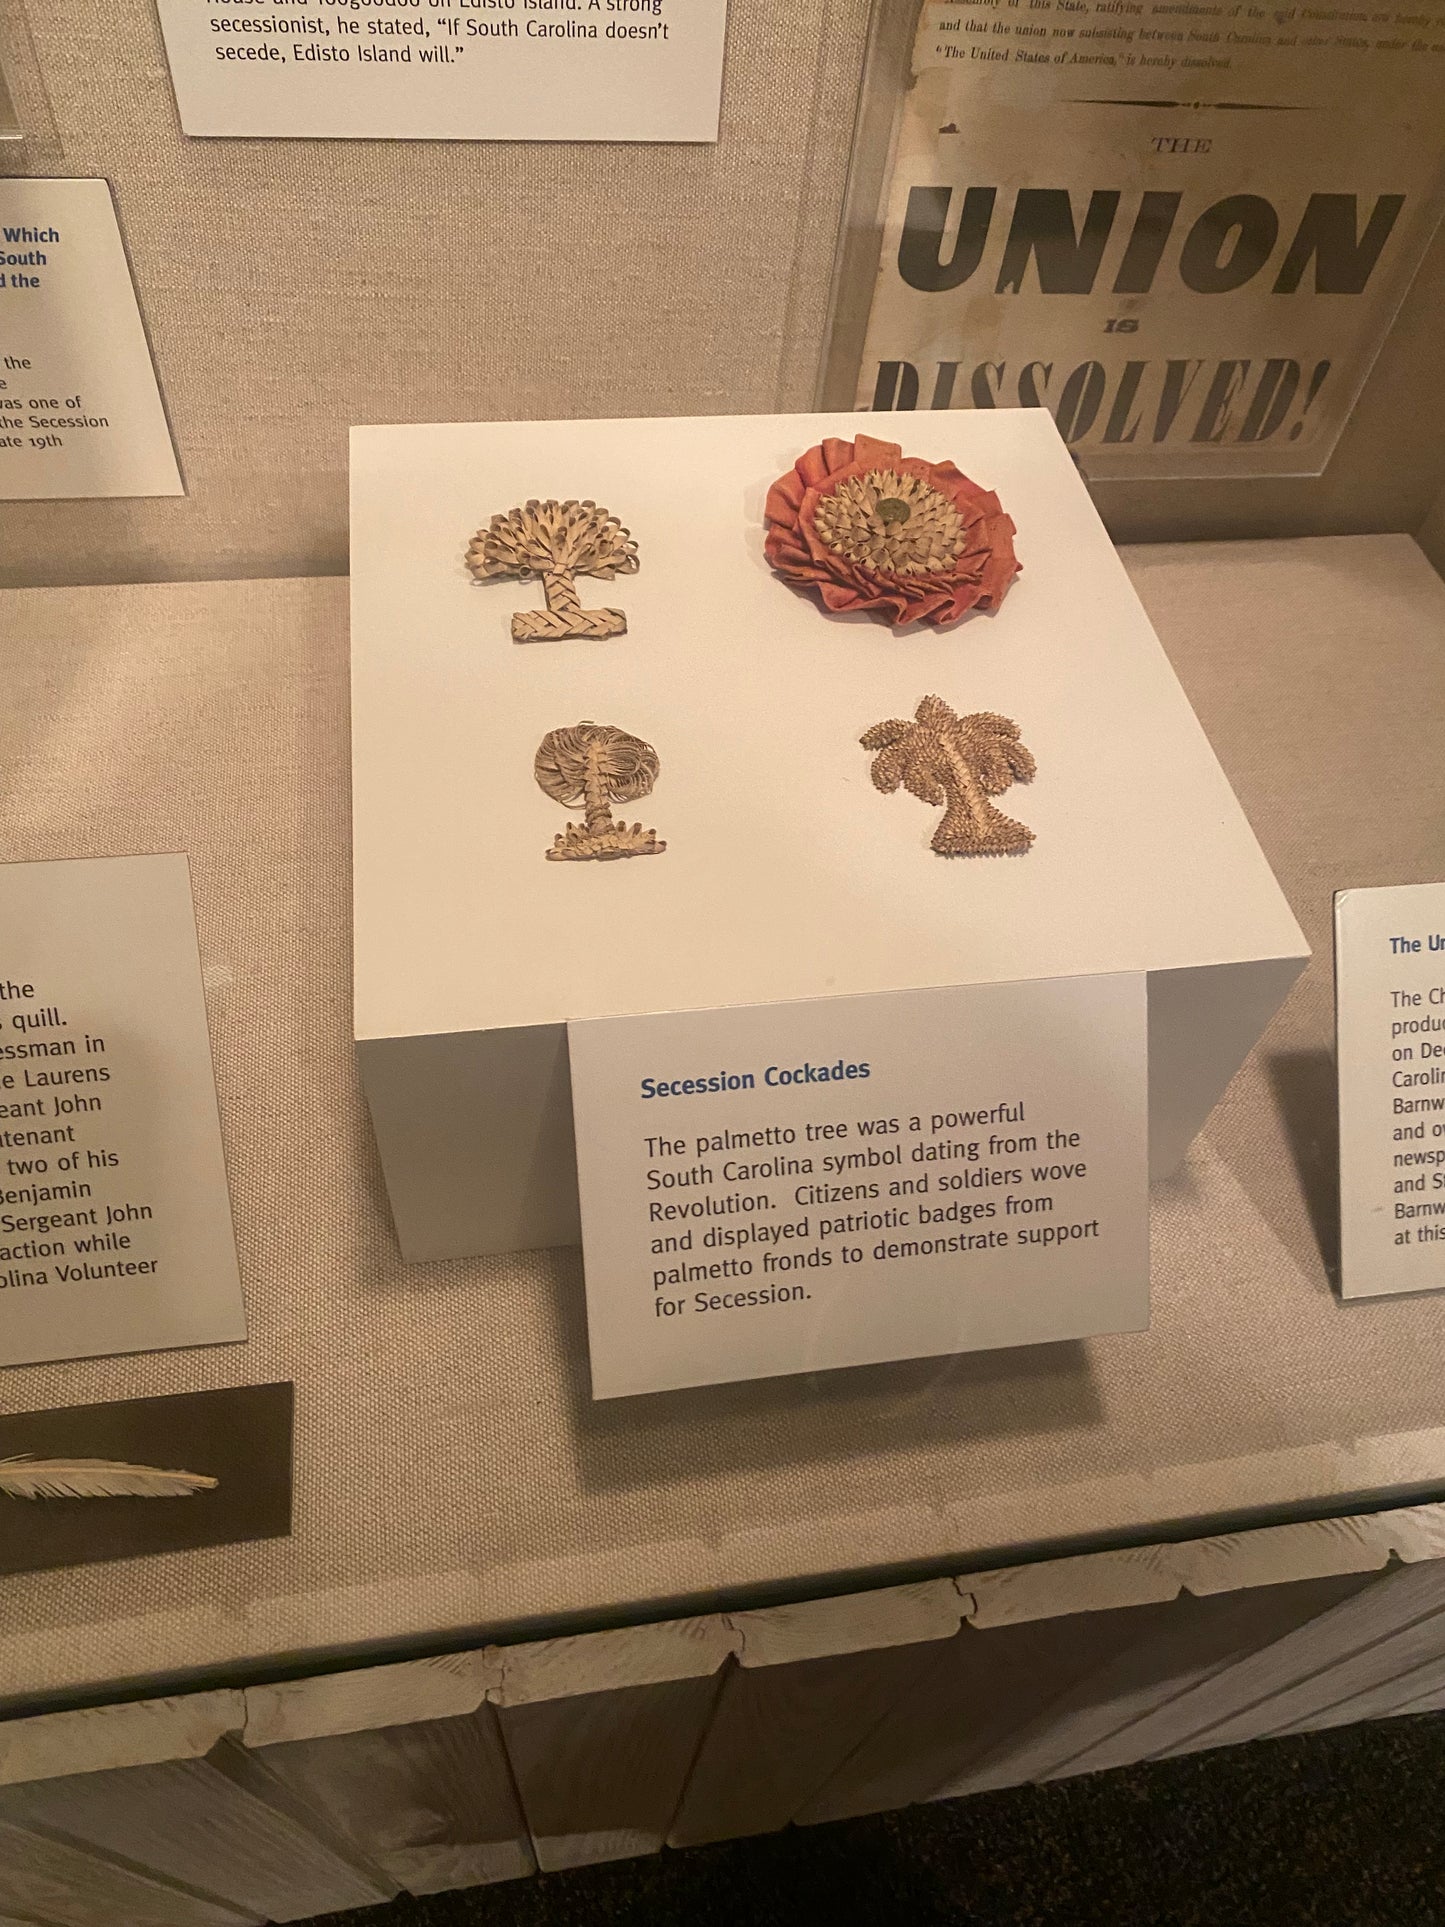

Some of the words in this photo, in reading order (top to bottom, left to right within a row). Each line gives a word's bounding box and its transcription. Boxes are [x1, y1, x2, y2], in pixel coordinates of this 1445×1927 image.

[607, 0, 662, 15] strong
[1056, 0, 1089, 14] State,
[211, 15, 329, 36] secessionist,
[337, 16, 359, 34] he
[368, 17, 430, 38] stated,
[438, 18, 460, 36] “If
[467, 19, 518, 36] South
[527, 20, 597, 38] Carolina
[606, 21, 668, 39] doesn’t
[939, 19, 960, 31] and
[965, 19, 988, 33] that
[992, 21, 1011, 34] the
[1015, 23, 1047, 36] union
[1052, 28, 1075, 38] now
[216, 43, 285, 63] secede,
[293, 43, 349, 61] Edisto
[358, 44, 411, 62] Island
[419, 45, 463, 63] will.”
[970, 47, 1008, 62] United
[1015, 49, 1050, 63] States
[1054, 51, 1066, 64] of
[1151, 137, 1212, 153] THE
[3, 227, 59, 242] Which
[898, 186, 1407, 295] UNION
[11, 273, 40, 288] the
[1103, 319, 1139, 333] IS
[4, 356, 31, 369] the
[0, 399, 22, 409] as
[29, 399, 59, 409] one
[66, 395, 81, 408] of
[872, 359, 1331, 444] DISSOLVED!
[29, 415, 109, 428] Secession
[29, 434, 62, 449] 19th
[1389, 937, 1421, 954] The
[0, 981, 34, 1000] the
[1390, 991, 1421, 1007] The
[12, 1007, 67, 1033] quill.
[85, 1035, 105, 1053] in
[1392, 1048, 1413, 1061] on
[24, 1068, 110, 1087] Laurens
[641, 1071, 755, 1098] Secession
[764, 1060, 870, 1086] Cockades
[54, 1094, 101, 1117] John
[0, 1125, 75, 1147] tenant
[644, 1136, 686, 1157] The
[697, 1127, 795, 1160] palmetto
[805, 1124, 847, 1141] tree
[857, 1119, 899, 1136] was
[909, 1117, 921, 1131] a
[932, 1101, 1024, 1134] powerful
[1393, 1121, 1424, 1141] and
[7, 1159, 48, 1175] two
[58, 1151, 79, 1171] of
[87, 1150, 119, 1168] his
[647, 1164, 713, 1190] South
[723, 1156, 813, 1181] Carolina
[823, 1145, 902, 1175] symbol
[912, 1140, 980, 1162] dating
[989, 1135, 1036, 1155] from
[1046, 1129, 1080, 1149] the
[1394, 1150, 1445, 1167] newsp
[650, 1193, 776, 1222] Revolution.
[795, 1184, 879, 1205] Citizens
[889, 1173, 928, 1196] and
[938, 1167, 1022, 1191] soldiers
[1031, 1163, 1086, 1181] wove
[1394, 1174, 1425, 1193] and
[1, 1209, 98, 1233] Sergeant
[107, 1204, 152, 1226] John
[651, 1230, 692, 1254] and
[703, 1217, 809, 1249] displayed
[820, 1208, 910, 1240] patriotic
[919, 1201, 996, 1224] badges
[1006, 1195, 1052, 1215] from
[1395, 1230, 1410, 1245] at
[1418, 1224, 1445, 1242] this
[0, 1240, 65, 1260] action
[74, 1232, 130, 1253] while
[654, 1259, 752, 1291] palmetto
[763, 1247, 832, 1272] fronds
[841, 1246, 863, 1263] to
[873, 1231, 1008, 1259] demonstrate
[1018, 1220, 1099, 1246] support
[55, 1260, 158, 1282] Volunteer
[655, 1297, 685, 1317] for
[695, 1284, 811, 1312] Secession.
